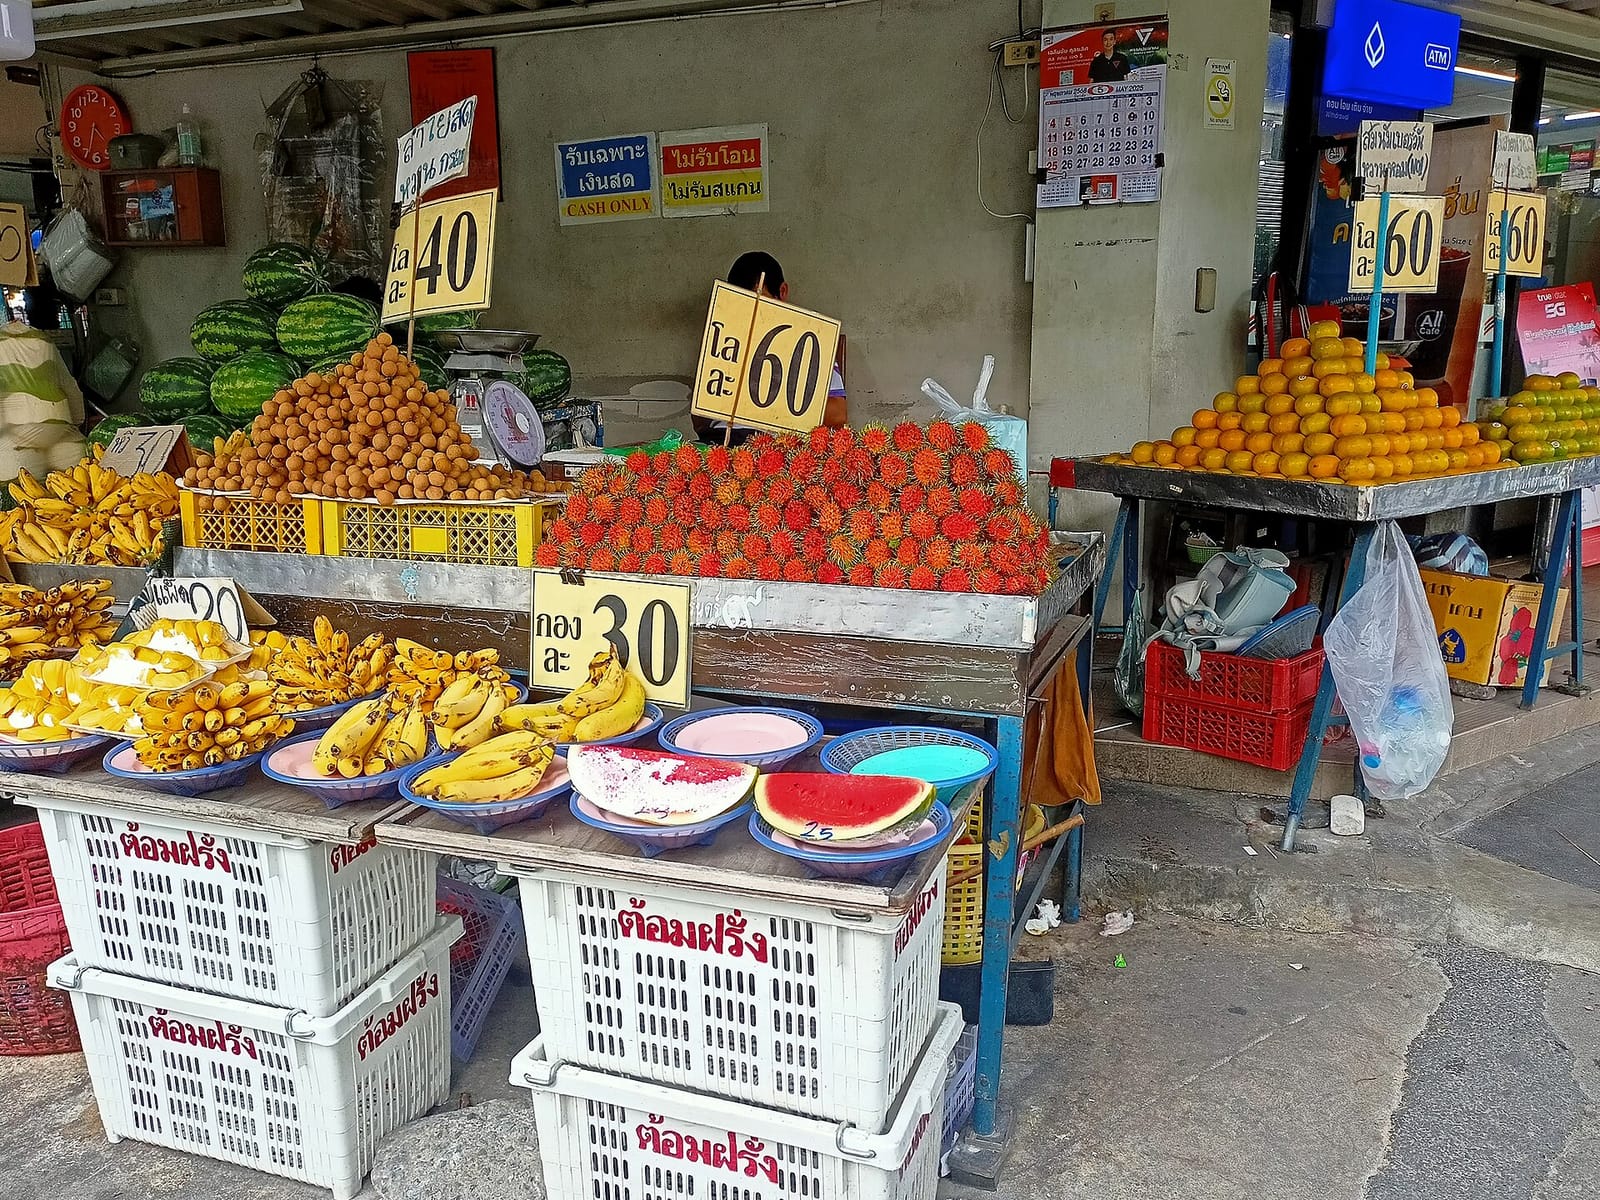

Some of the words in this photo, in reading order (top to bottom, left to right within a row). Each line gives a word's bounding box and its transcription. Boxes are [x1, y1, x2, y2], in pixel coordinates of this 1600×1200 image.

[1428, 50, 1447, 65] ATM
[86, 90, 98, 103] 12
[1115, 85, 1128, 93] MAY
[1128, 84, 1144, 92] 2025
[79, 96, 86, 106] 11
[102, 97, 106, 107] 1
[1130, 98, 1136, 107] 2
[1146, 97, 1152, 105] 3
[70, 108, 81, 118] 10
[109, 106, 116, 117] 2
[1049, 119, 1056, 128] 4
[1065, 117, 1071, 126] 5
[1081, 116, 1087, 125] 6
[1097, 114, 1102, 123] 7
[1113, 113, 1119, 122] 8
[1144, 111, 1154, 120] 10
[68, 121, 76, 133] 9
[114, 123, 120, 135] 3
[403, 99, 474, 163] ลำไยสด
[1048, 133, 1057, 142] 11
[1063, 132, 1073, 141] 12
[1078, 130, 1089, 139] 13
[1094, 129, 1105, 138] 14
[1110, 128, 1121, 137] 15
[1127, 126, 1138, 136] 16
[1143, 125, 1154, 135] 17
[73, 136, 80, 147] 8
[1048, 147, 1058, 157] 18
[1063, 146, 1073, 155] 19
[1077, 144, 1088, 154] 20
[1093, 143, 1104, 152] 21
[1109, 142, 1121, 152] 22
[1125, 141, 1137, 151] 23
[1142, 140, 1153, 149] 24
[82, 148, 89, 159] 7
[92, 152, 100, 163] 6
[566, 142, 645, 166] รับเฉพาะ
[671, 145, 756, 169] ไม่รับโอน
[1047, 162, 1058, 171] 25
[1062, 160, 1073, 169] 26
[1077, 159, 1088, 168] 27
[1093, 158, 1104, 167] 28
[1109, 157, 1120, 166] 29
[1125, 155, 1136, 165] 30
[1141, 154, 1152, 163] 31
[579, 172, 635, 192] เงินสด
[668, 179, 762, 200] ไม่รับสแกน
[567, 201, 606, 217] CASH
[610, 196, 651, 213] ONLY
[1488, 213, 1501, 237] โล
[1506, 205, 1537, 263] 60
[1356, 222, 1375, 249] โล
[1383, 209, 1433, 276] 60
[391, 243, 409, 273] โล
[416, 211, 478, 295] 40
[1488, 243, 1502, 260] ละ
[1356, 256, 1375, 276] ละ
[388, 280, 407, 304] ละ
[1537, 293, 1552, 302] true
[1420, 310, 1444, 327] All
[1544, 302, 1566, 319] 5G
[1419, 326, 1440, 336] Cafe
[711, 321, 740, 363] โล
[748, 324, 820, 416] 60
[706, 368, 735, 397] ละ
[1448, 603, 1484, 620] FUJI
[536, 613, 582, 640] กอง
[593, 594, 679, 687] 30
[544, 647, 570, 673] ละ
[800, 821, 834, 841] 25
[119, 822, 232, 873] ต้อมฝรั่ง
[617, 897, 768, 964] ต้อมฝรั่ง
[356, 971, 439, 1062] ต้อมฝรั่ง
[148, 1007, 258, 1061] ต้อมฝรั่ง
[635, 1113, 779, 1185] ต้อมฝรั่ง
